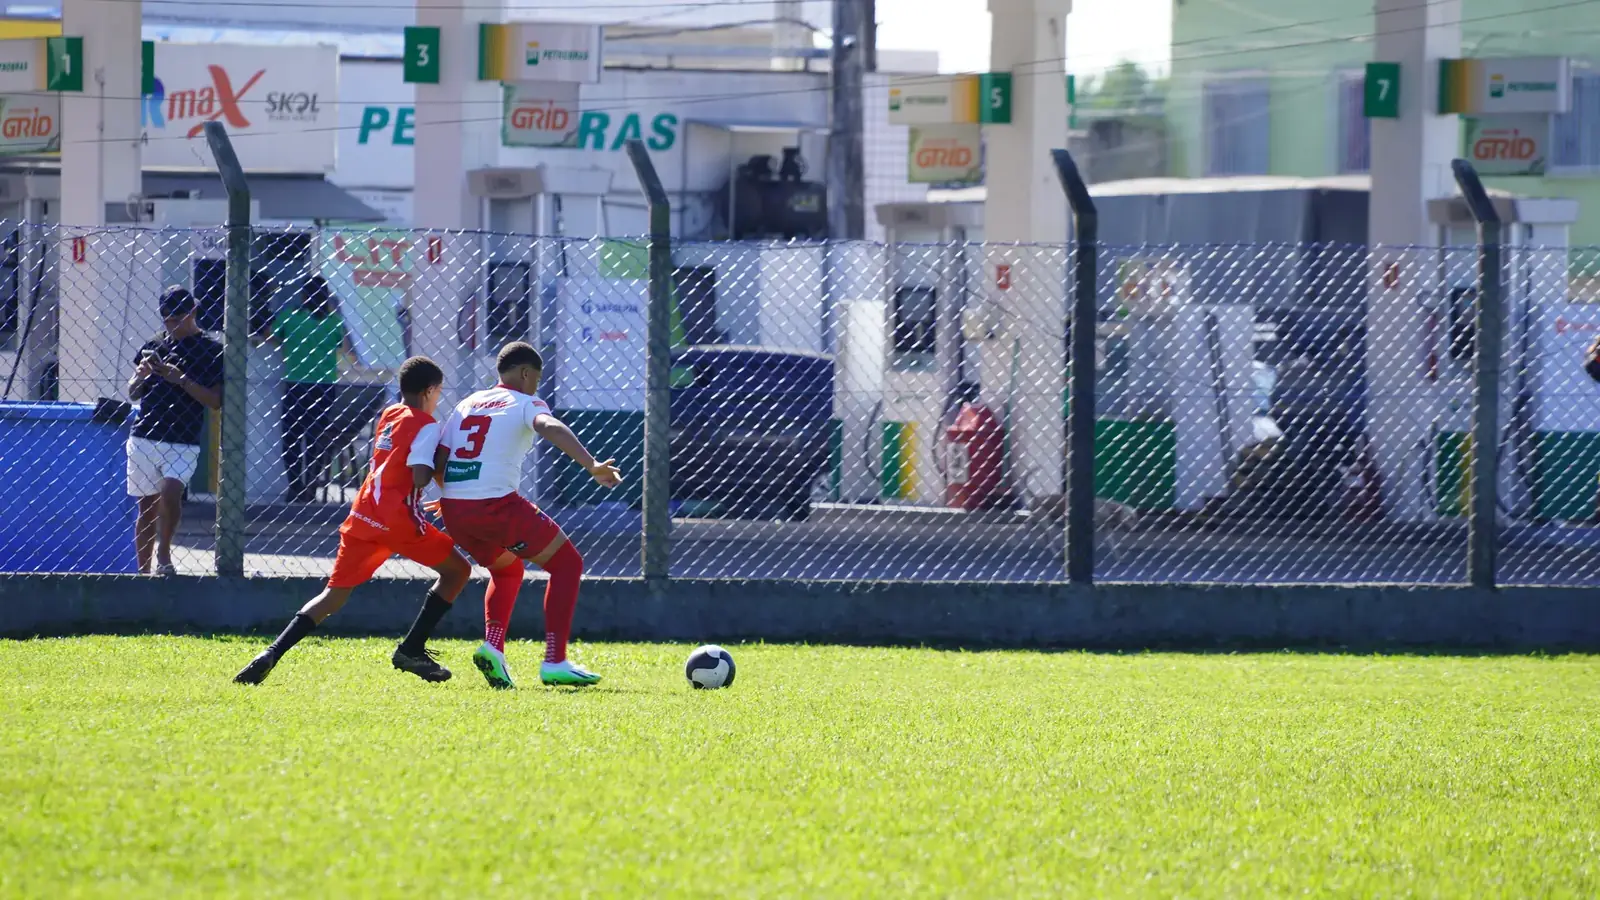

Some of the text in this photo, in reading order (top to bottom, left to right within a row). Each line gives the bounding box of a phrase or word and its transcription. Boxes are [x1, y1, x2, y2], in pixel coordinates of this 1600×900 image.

[61, 53, 71, 76] 1
[416, 43, 430, 67] 3
[265, 91, 320, 114] SKOL
[991, 87, 1003, 109] 5
[1377, 79, 1390, 102] 7
[2, 107, 52, 138] GRID
[511, 100, 569, 131] GRID
[1473, 128, 1536, 160] GRID
[455, 415, 492, 459] 3
